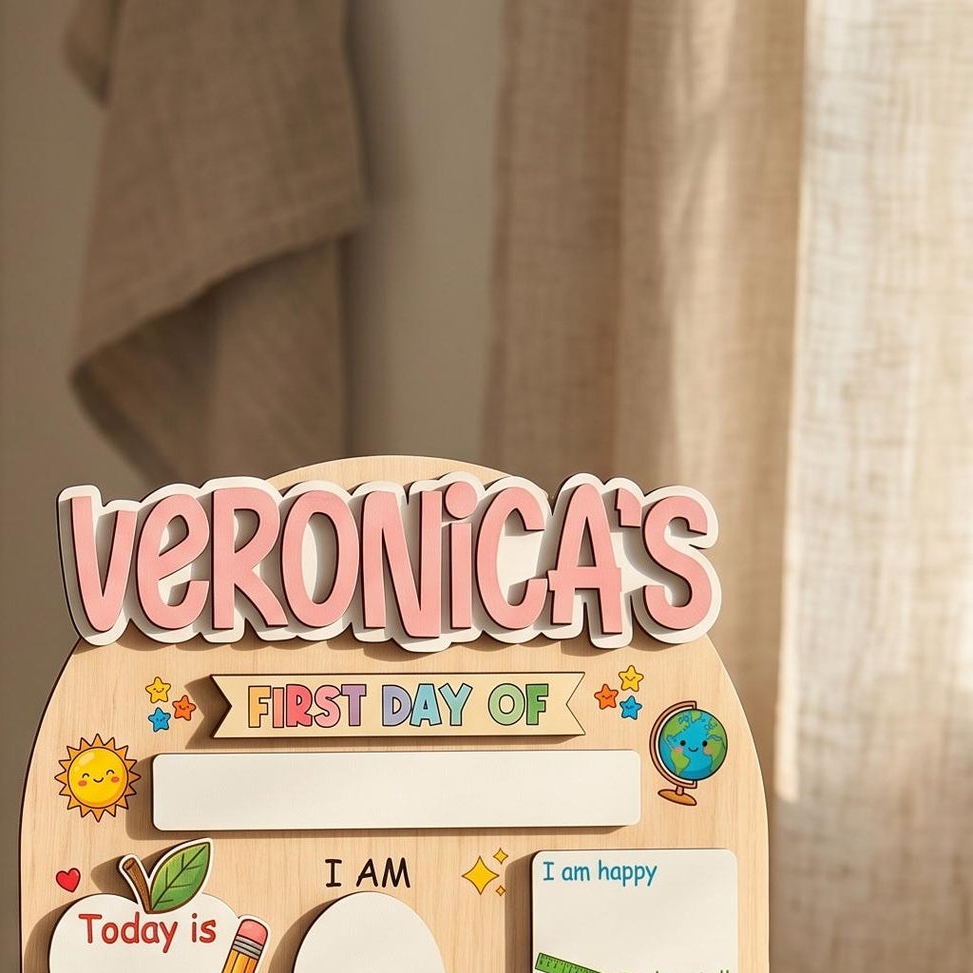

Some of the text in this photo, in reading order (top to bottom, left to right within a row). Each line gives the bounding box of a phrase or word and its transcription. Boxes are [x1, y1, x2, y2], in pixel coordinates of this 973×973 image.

[247, 682, 549, 729] FIRST DAY OF
[326, 858, 411, 887] I AM
[542, 861, 658, 886] I am happy
[79, 912, 217, 953] Today is
